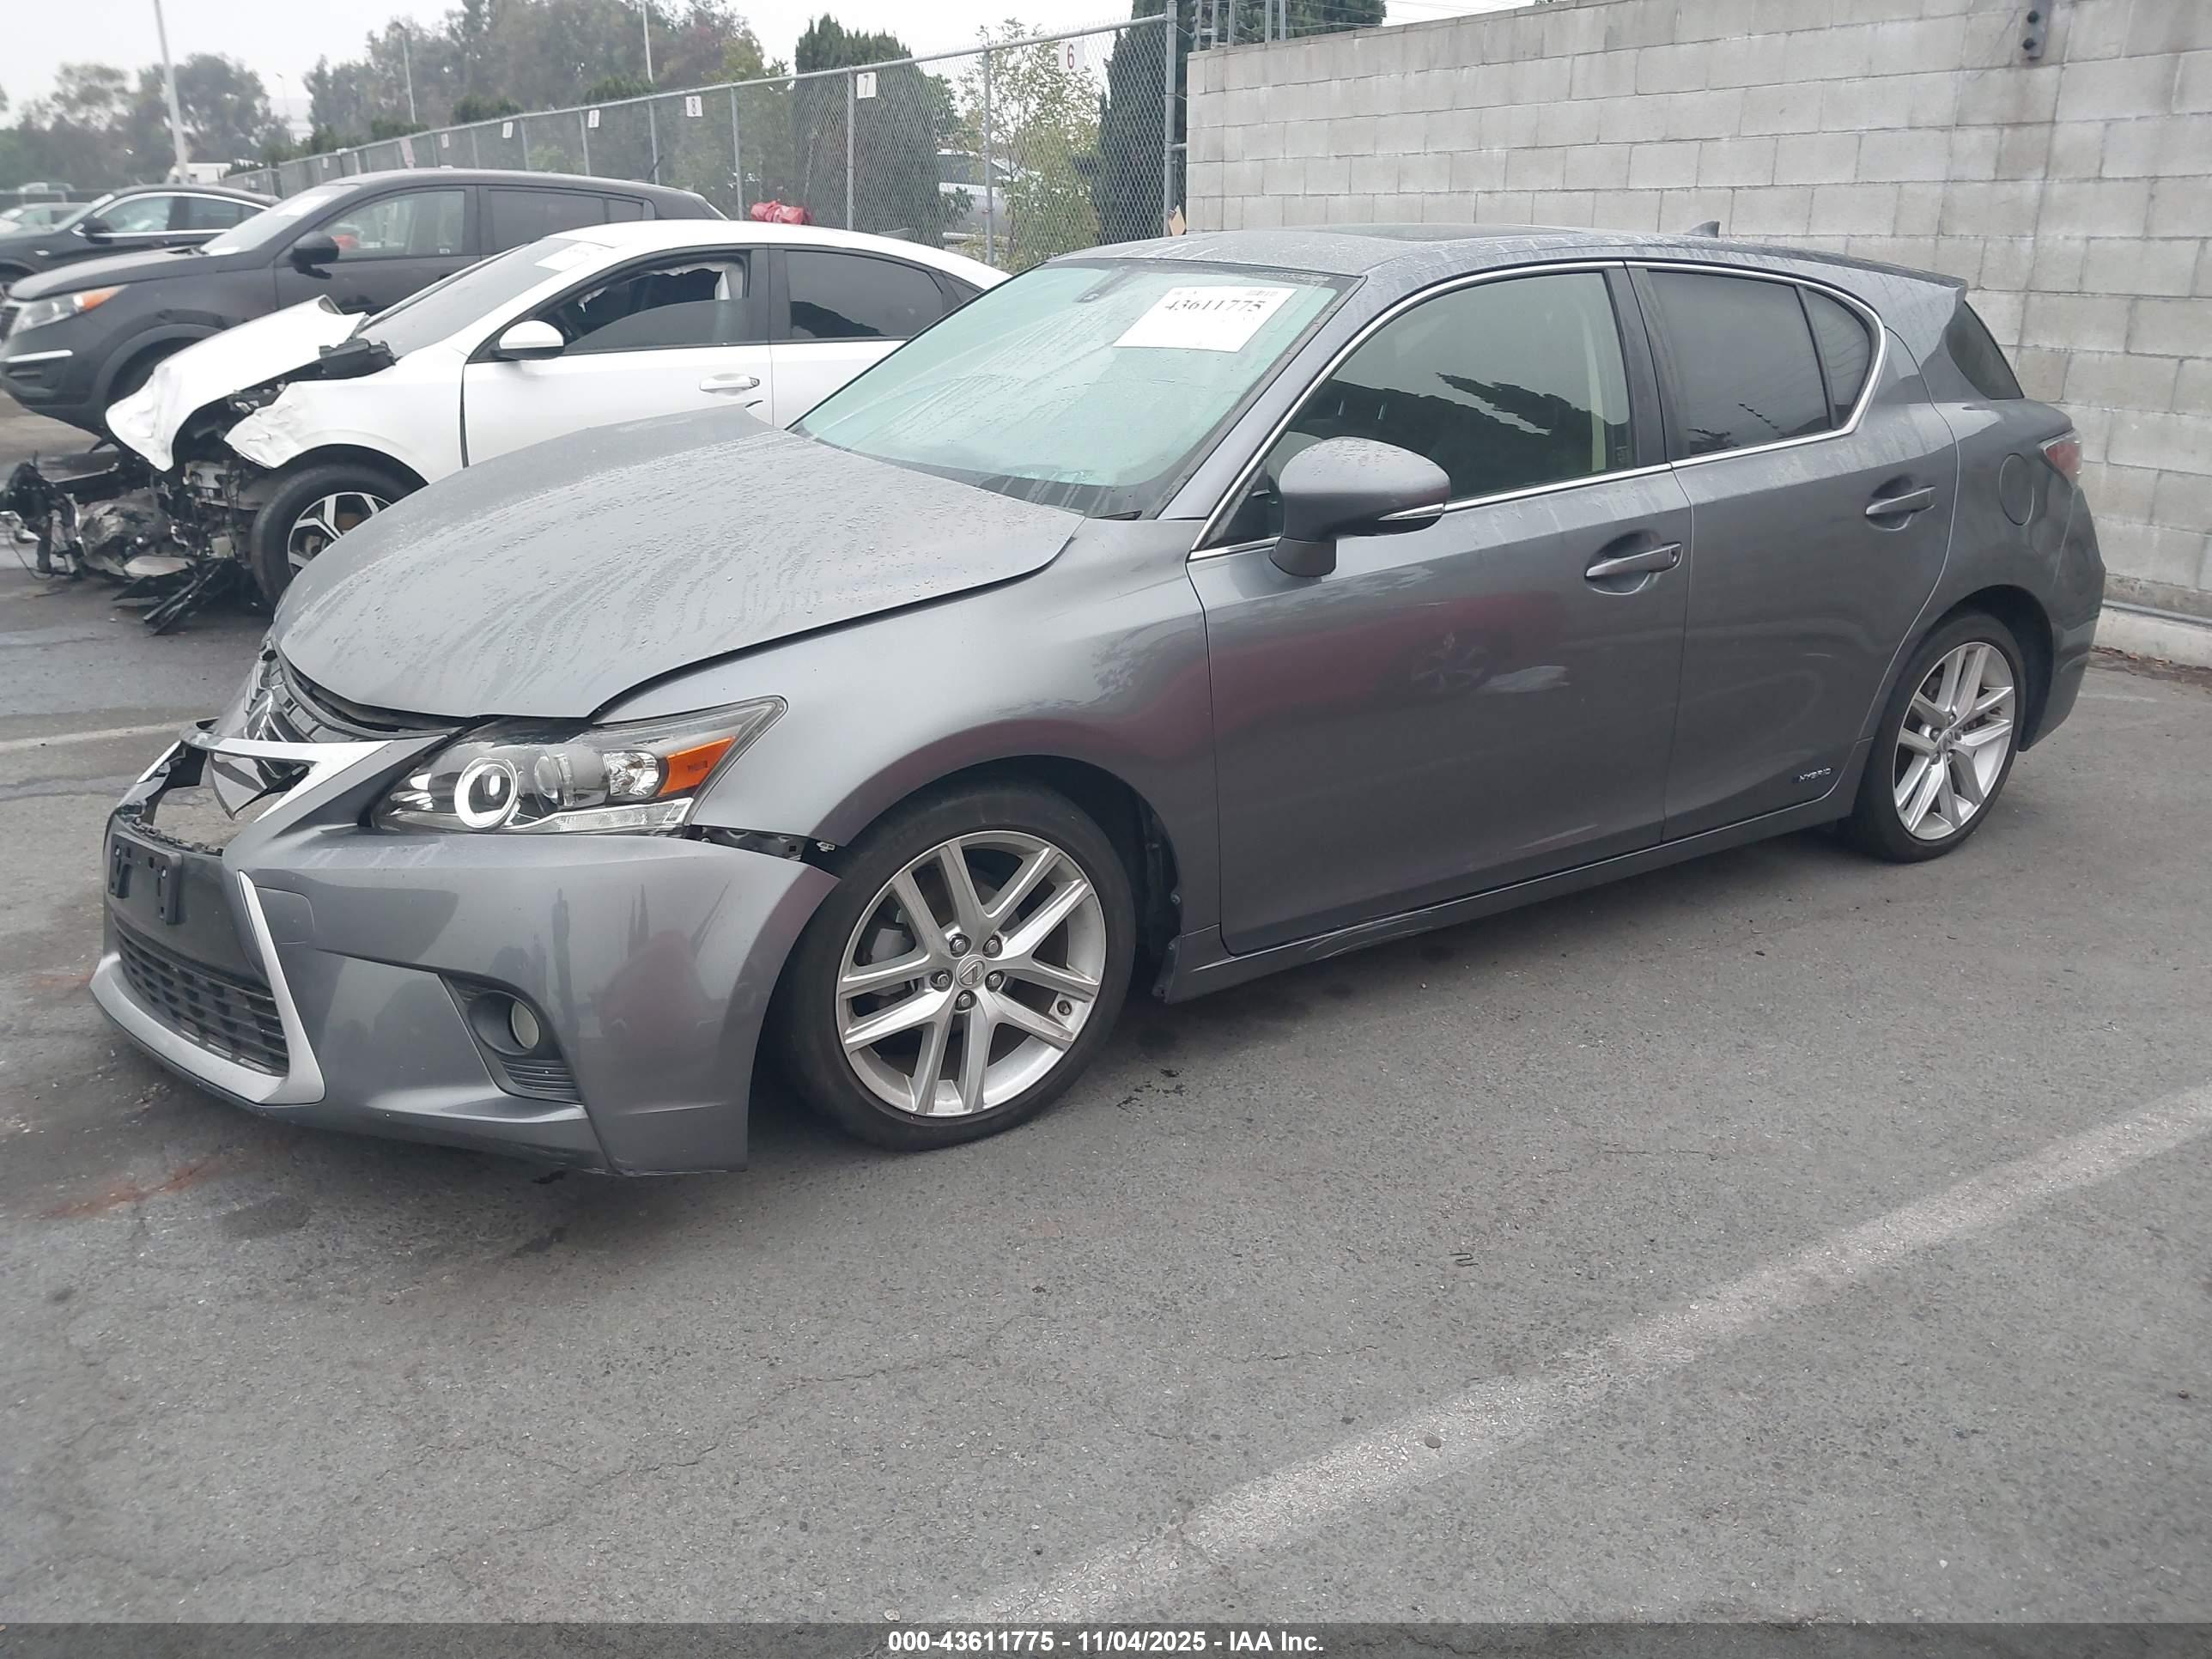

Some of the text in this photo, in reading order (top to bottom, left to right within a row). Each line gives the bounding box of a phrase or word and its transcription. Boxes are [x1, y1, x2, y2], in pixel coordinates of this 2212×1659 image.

[1066, 44, 1075, 70] 6
[863, 74, 872, 96] 7
[1164, 299, 1267, 312] 43611775
